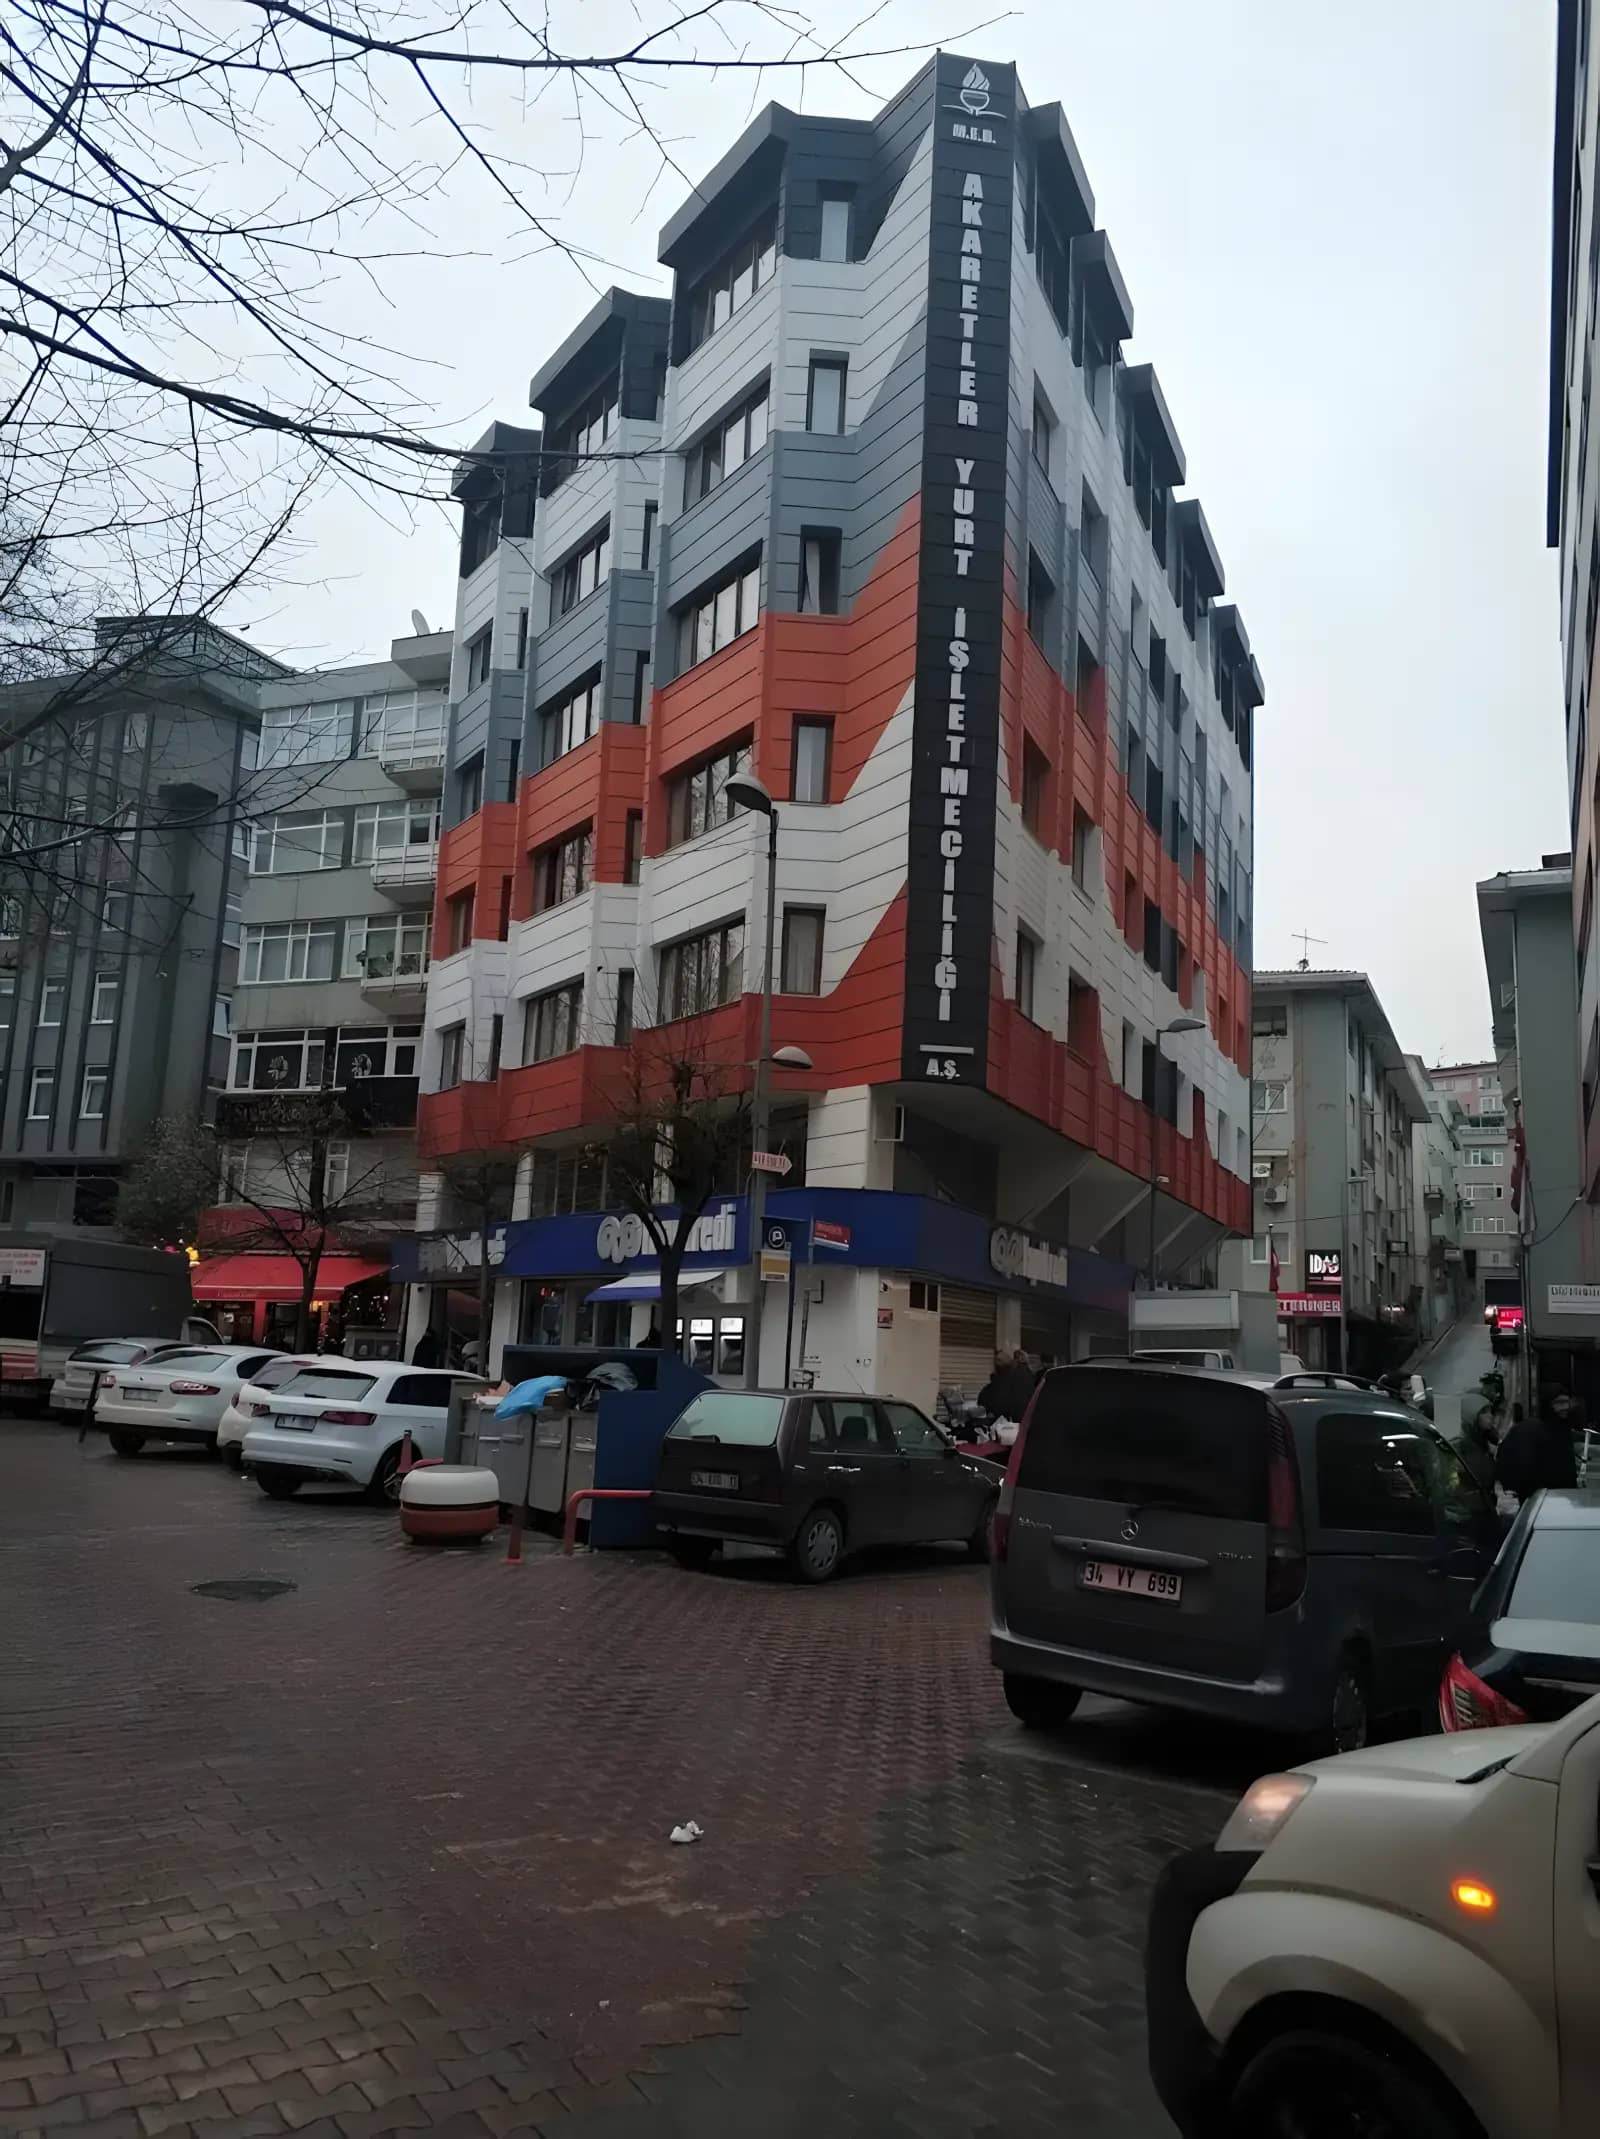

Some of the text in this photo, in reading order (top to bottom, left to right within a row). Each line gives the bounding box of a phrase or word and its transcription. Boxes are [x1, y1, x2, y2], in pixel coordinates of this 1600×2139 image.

[957, 172, 984, 427] AKARETLER
[953, 457, 976, 576] YURT
[925, 1057, 961, 1080] A.Ş.
[1086, 1562, 1178, 1595] 34 VY 699
